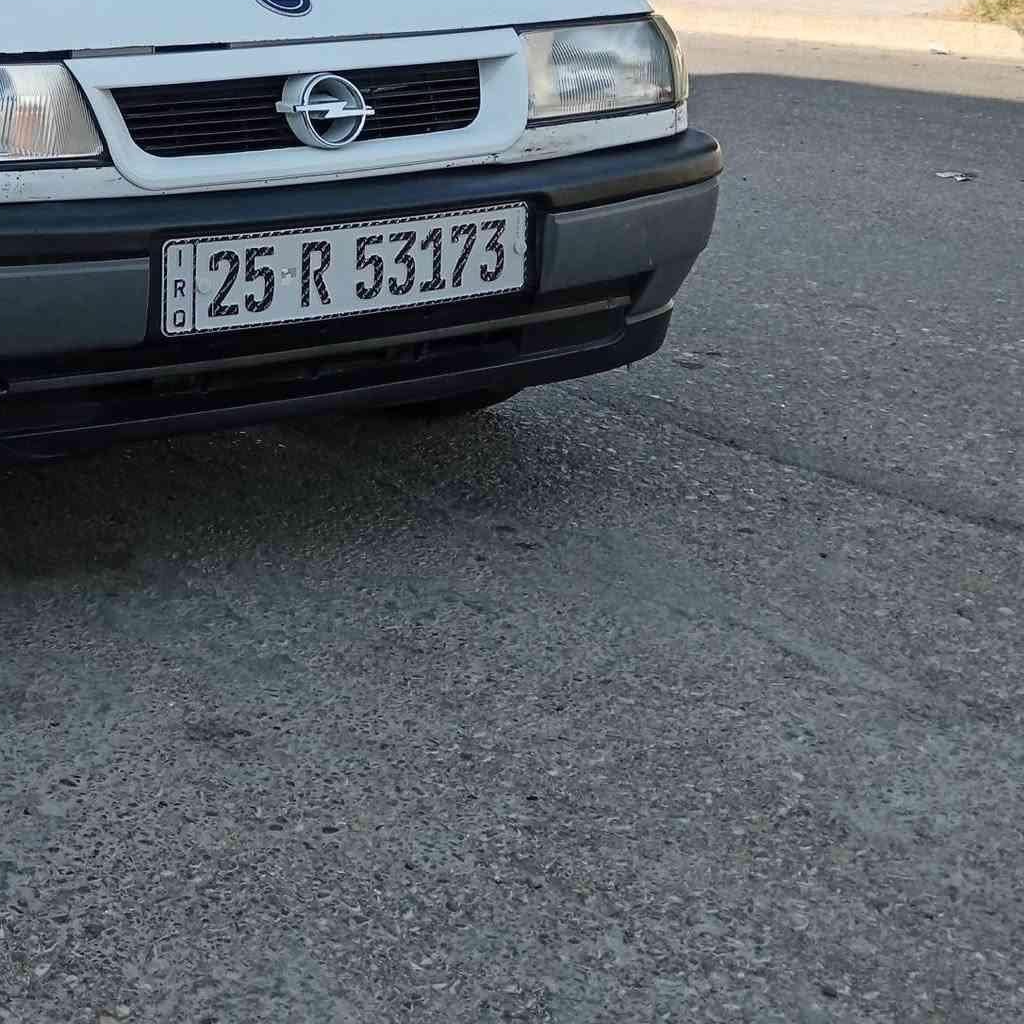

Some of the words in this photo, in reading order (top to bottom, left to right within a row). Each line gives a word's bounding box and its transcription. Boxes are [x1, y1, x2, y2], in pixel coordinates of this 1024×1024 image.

[207, 246, 275, 317] 25
[301, 240, 331, 307] R
[355, 218, 507, 299] 53173
